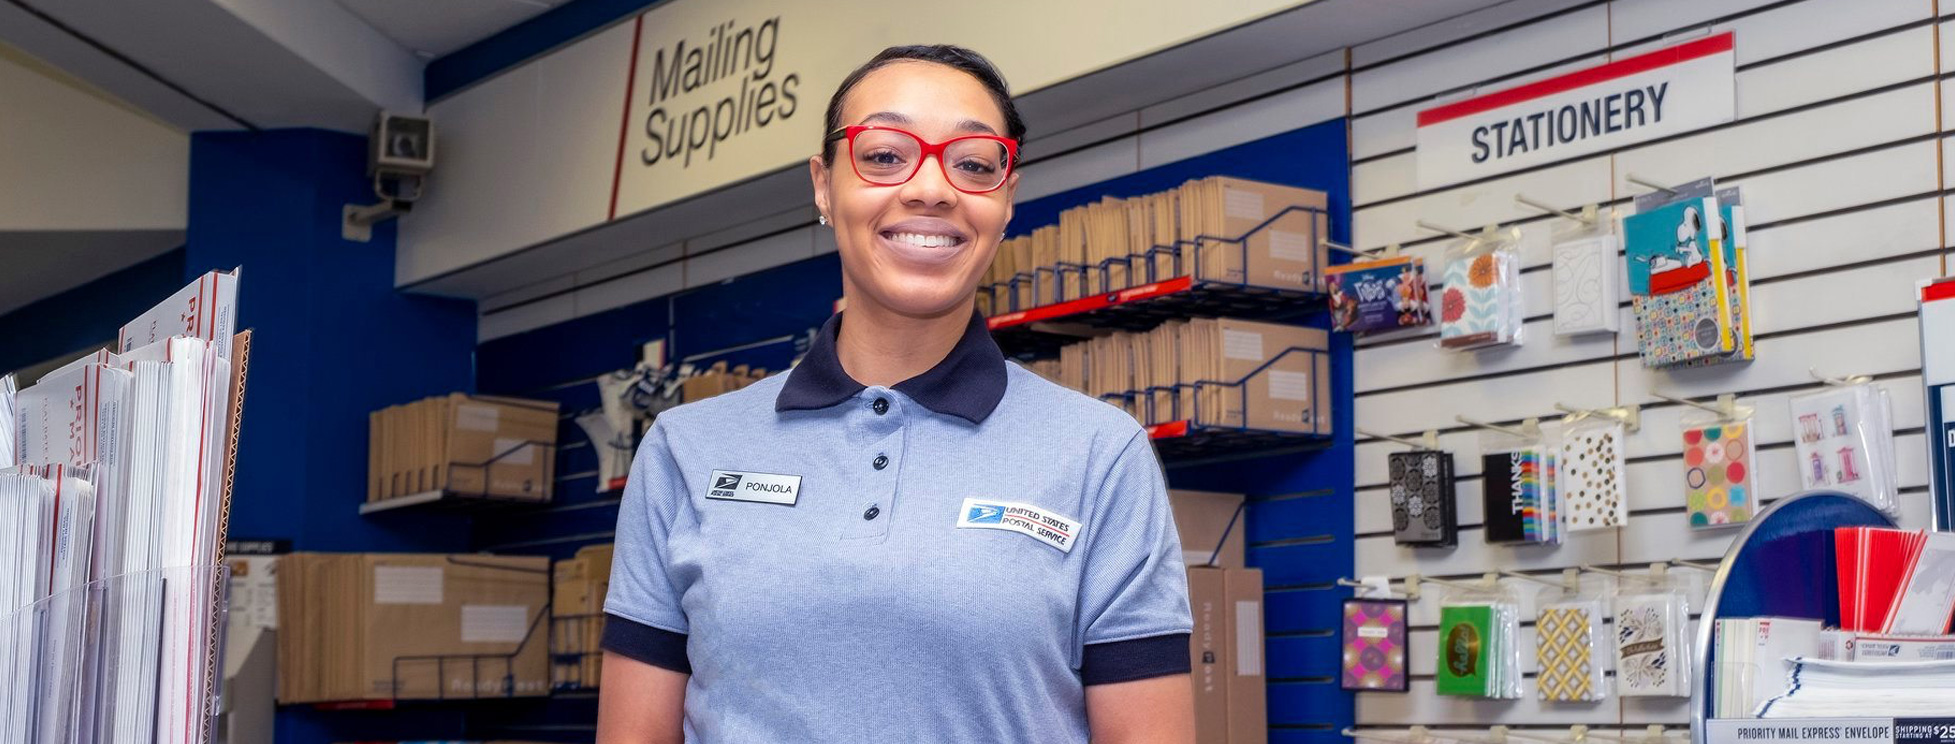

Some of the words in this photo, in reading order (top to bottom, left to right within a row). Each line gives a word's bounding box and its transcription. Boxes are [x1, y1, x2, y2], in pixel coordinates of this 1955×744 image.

[649, 16, 780, 106] Mailing
[641, 73, 800, 169] Supplies
[1471, 81, 1669, 163] STATIONERY
[745, 482, 792, 494] PONJOLA
[1511, 449, 1524, 515] THANKS
[1002, 517, 1034, 532] POSTAL
[1037, 527, 1066, 545] SERVICE
[1005, 506, 1040, 520] UNITED
[1042, 515, 1069, 532] STATES
[1738, 728, 1775, 740] PRIORITY
[1778, 728, 1798, 740] MAIL
[1845, 726, 1889, 739] ENVELOPE
[1895, 725, 1932, 734] SHIPPING
